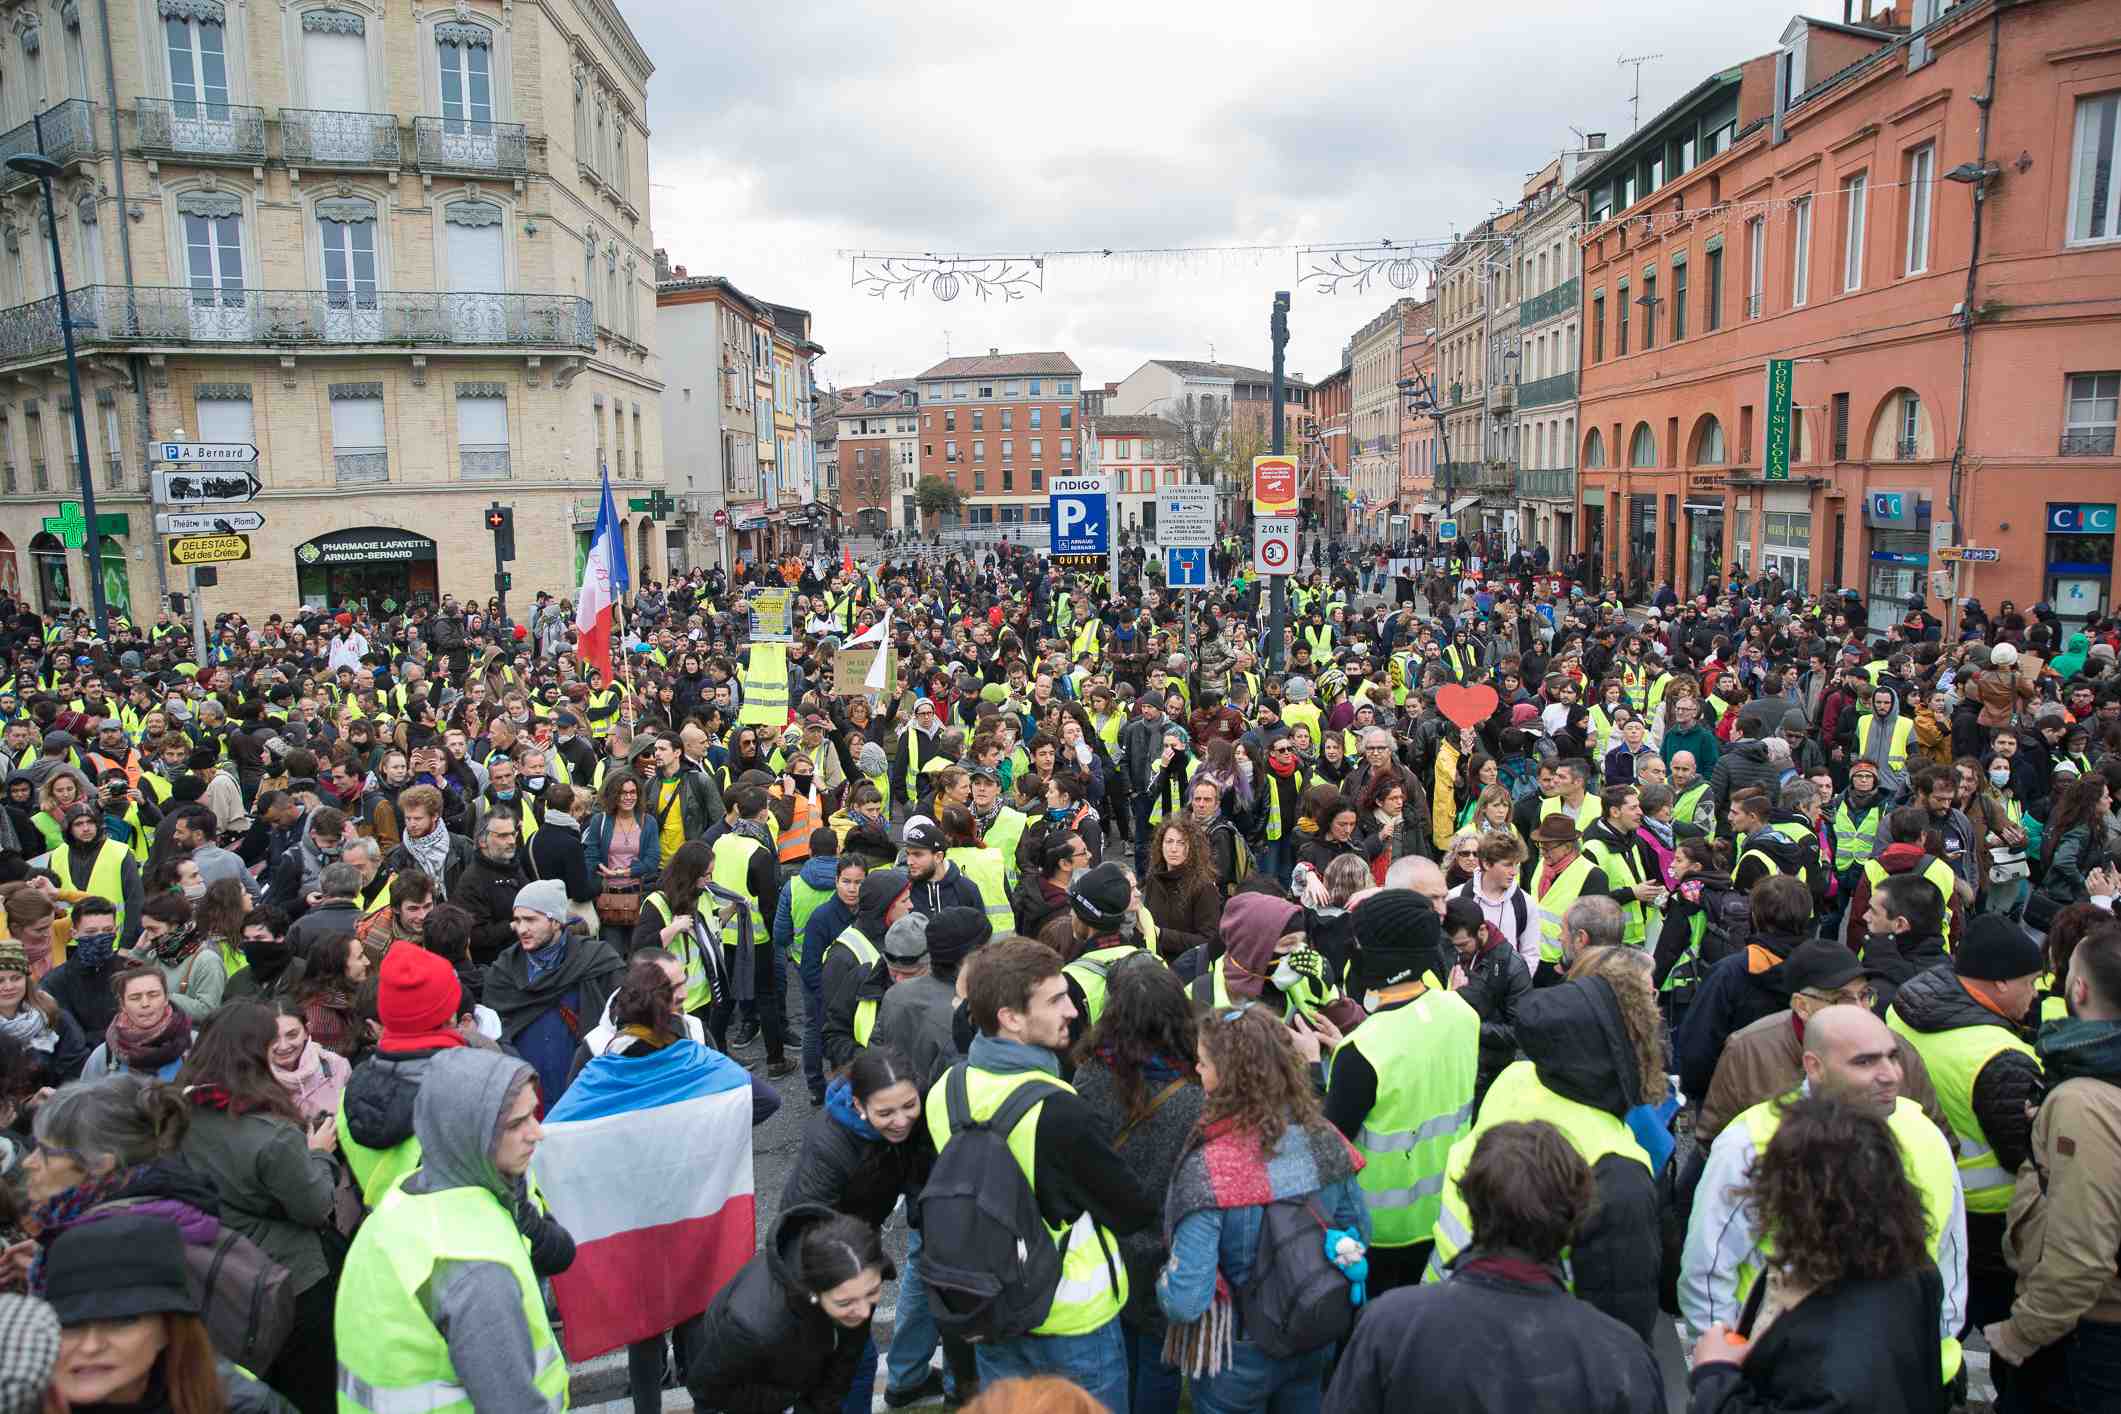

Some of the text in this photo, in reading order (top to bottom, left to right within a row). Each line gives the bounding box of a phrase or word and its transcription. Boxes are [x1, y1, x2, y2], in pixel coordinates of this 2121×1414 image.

[1775, 361, 1787, 412] FOURNIL
[198, 448, 243, 458] Bernard
[1770, 426, 1785, 479] NICOLAS
[1055, 481, 1100, 490] INDIGO
[1876, 498, 1900, 514] CIC
[233, 517, 256, 527] Plomb
[1057, 499, 1087, 537] P
[2053, 509, 2110, 528] CIC
[1261, 525, 1289, 534] ZONE
[322, 540, 431, 551] PHARMACIE LAFAYETTE
[183, 552, 195, 560] Bd
[197, 551, 212, 559] des
[324, 551, 413, 561] ARNAUD-BERNARD
[1059, 556, 1099, 565] OUVERT
